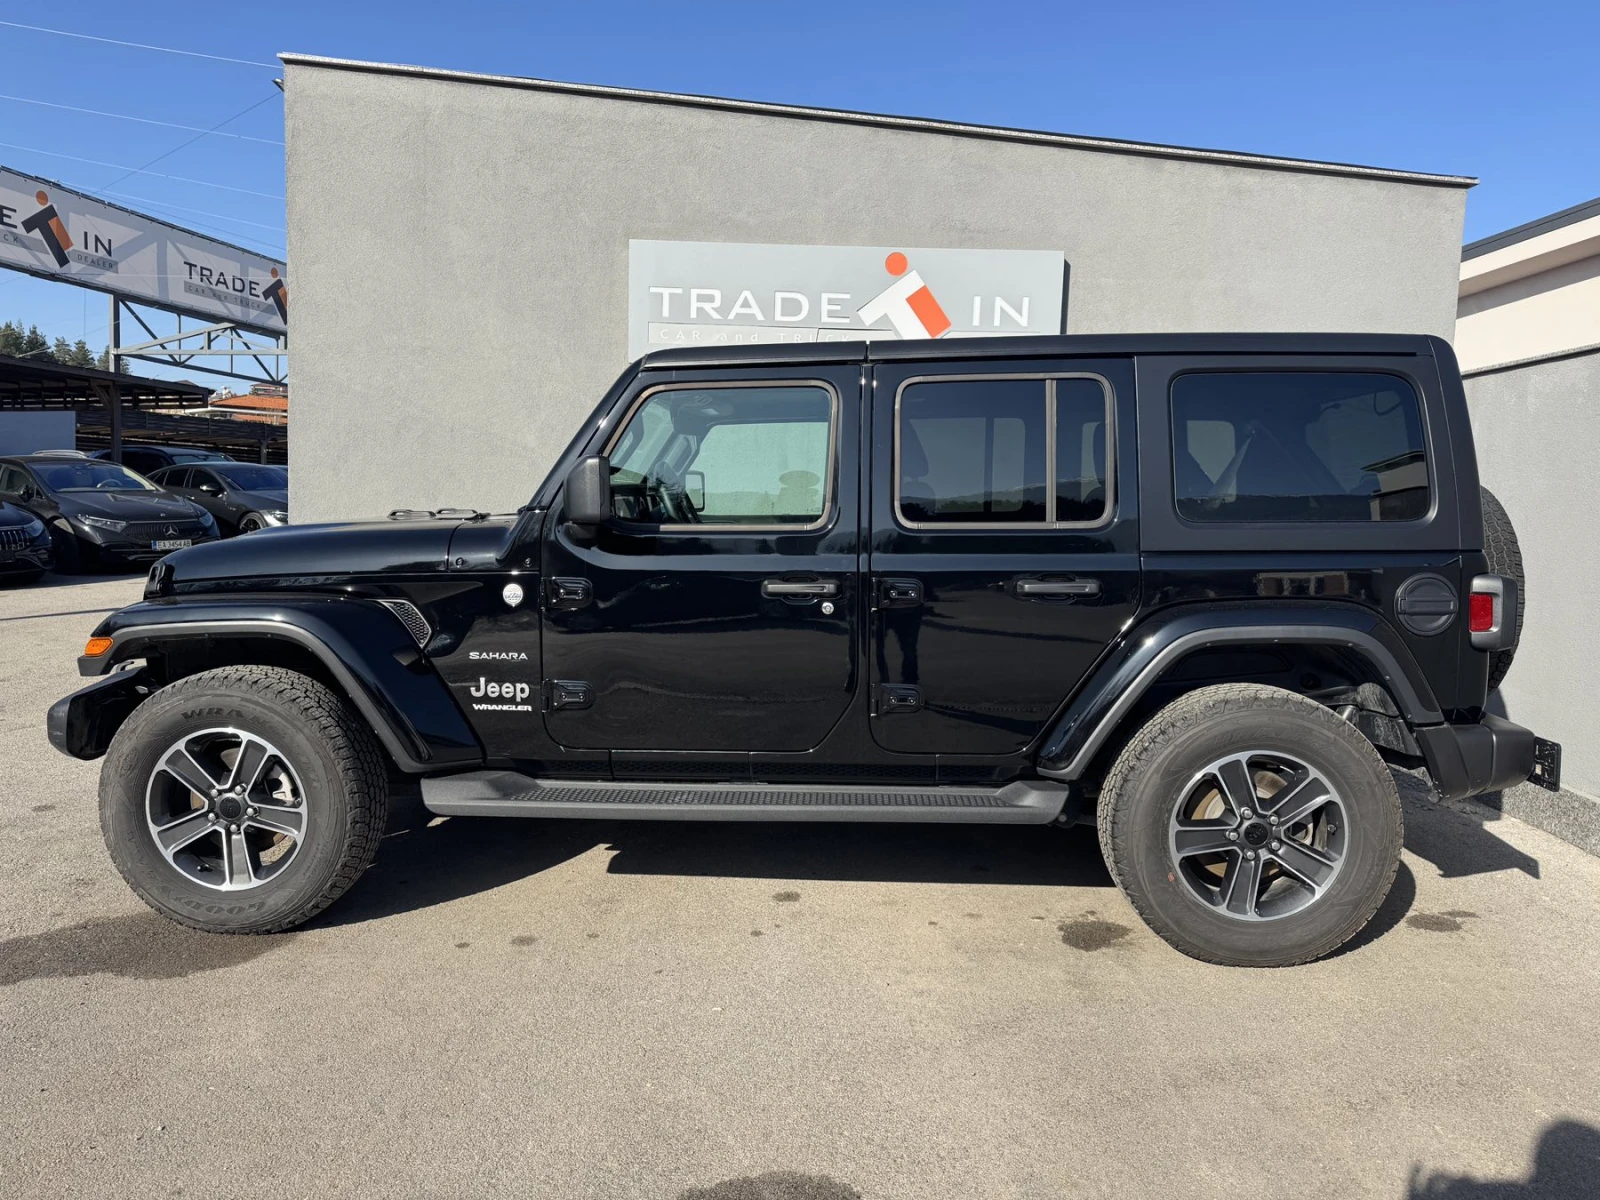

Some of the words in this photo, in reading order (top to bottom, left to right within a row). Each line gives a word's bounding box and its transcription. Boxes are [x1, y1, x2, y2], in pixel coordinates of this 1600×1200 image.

[84, 231, 112, 257] IN
[77, 254, 113, 269] DEALER
[183, 261, 260, 298] TRADE
[188, 285, 206, 295] CAR
[648, 286, 851, 324] TRADE
[971, 295, 1030, 327] IN
[660, 329, 701, 340] CAR
[719, 332, 758, 342] and
[469, 652, 528, 660] SAHARA
[470, 677, 530, 702] Jeep
[472, 703, 532, 712] WRANGLER
